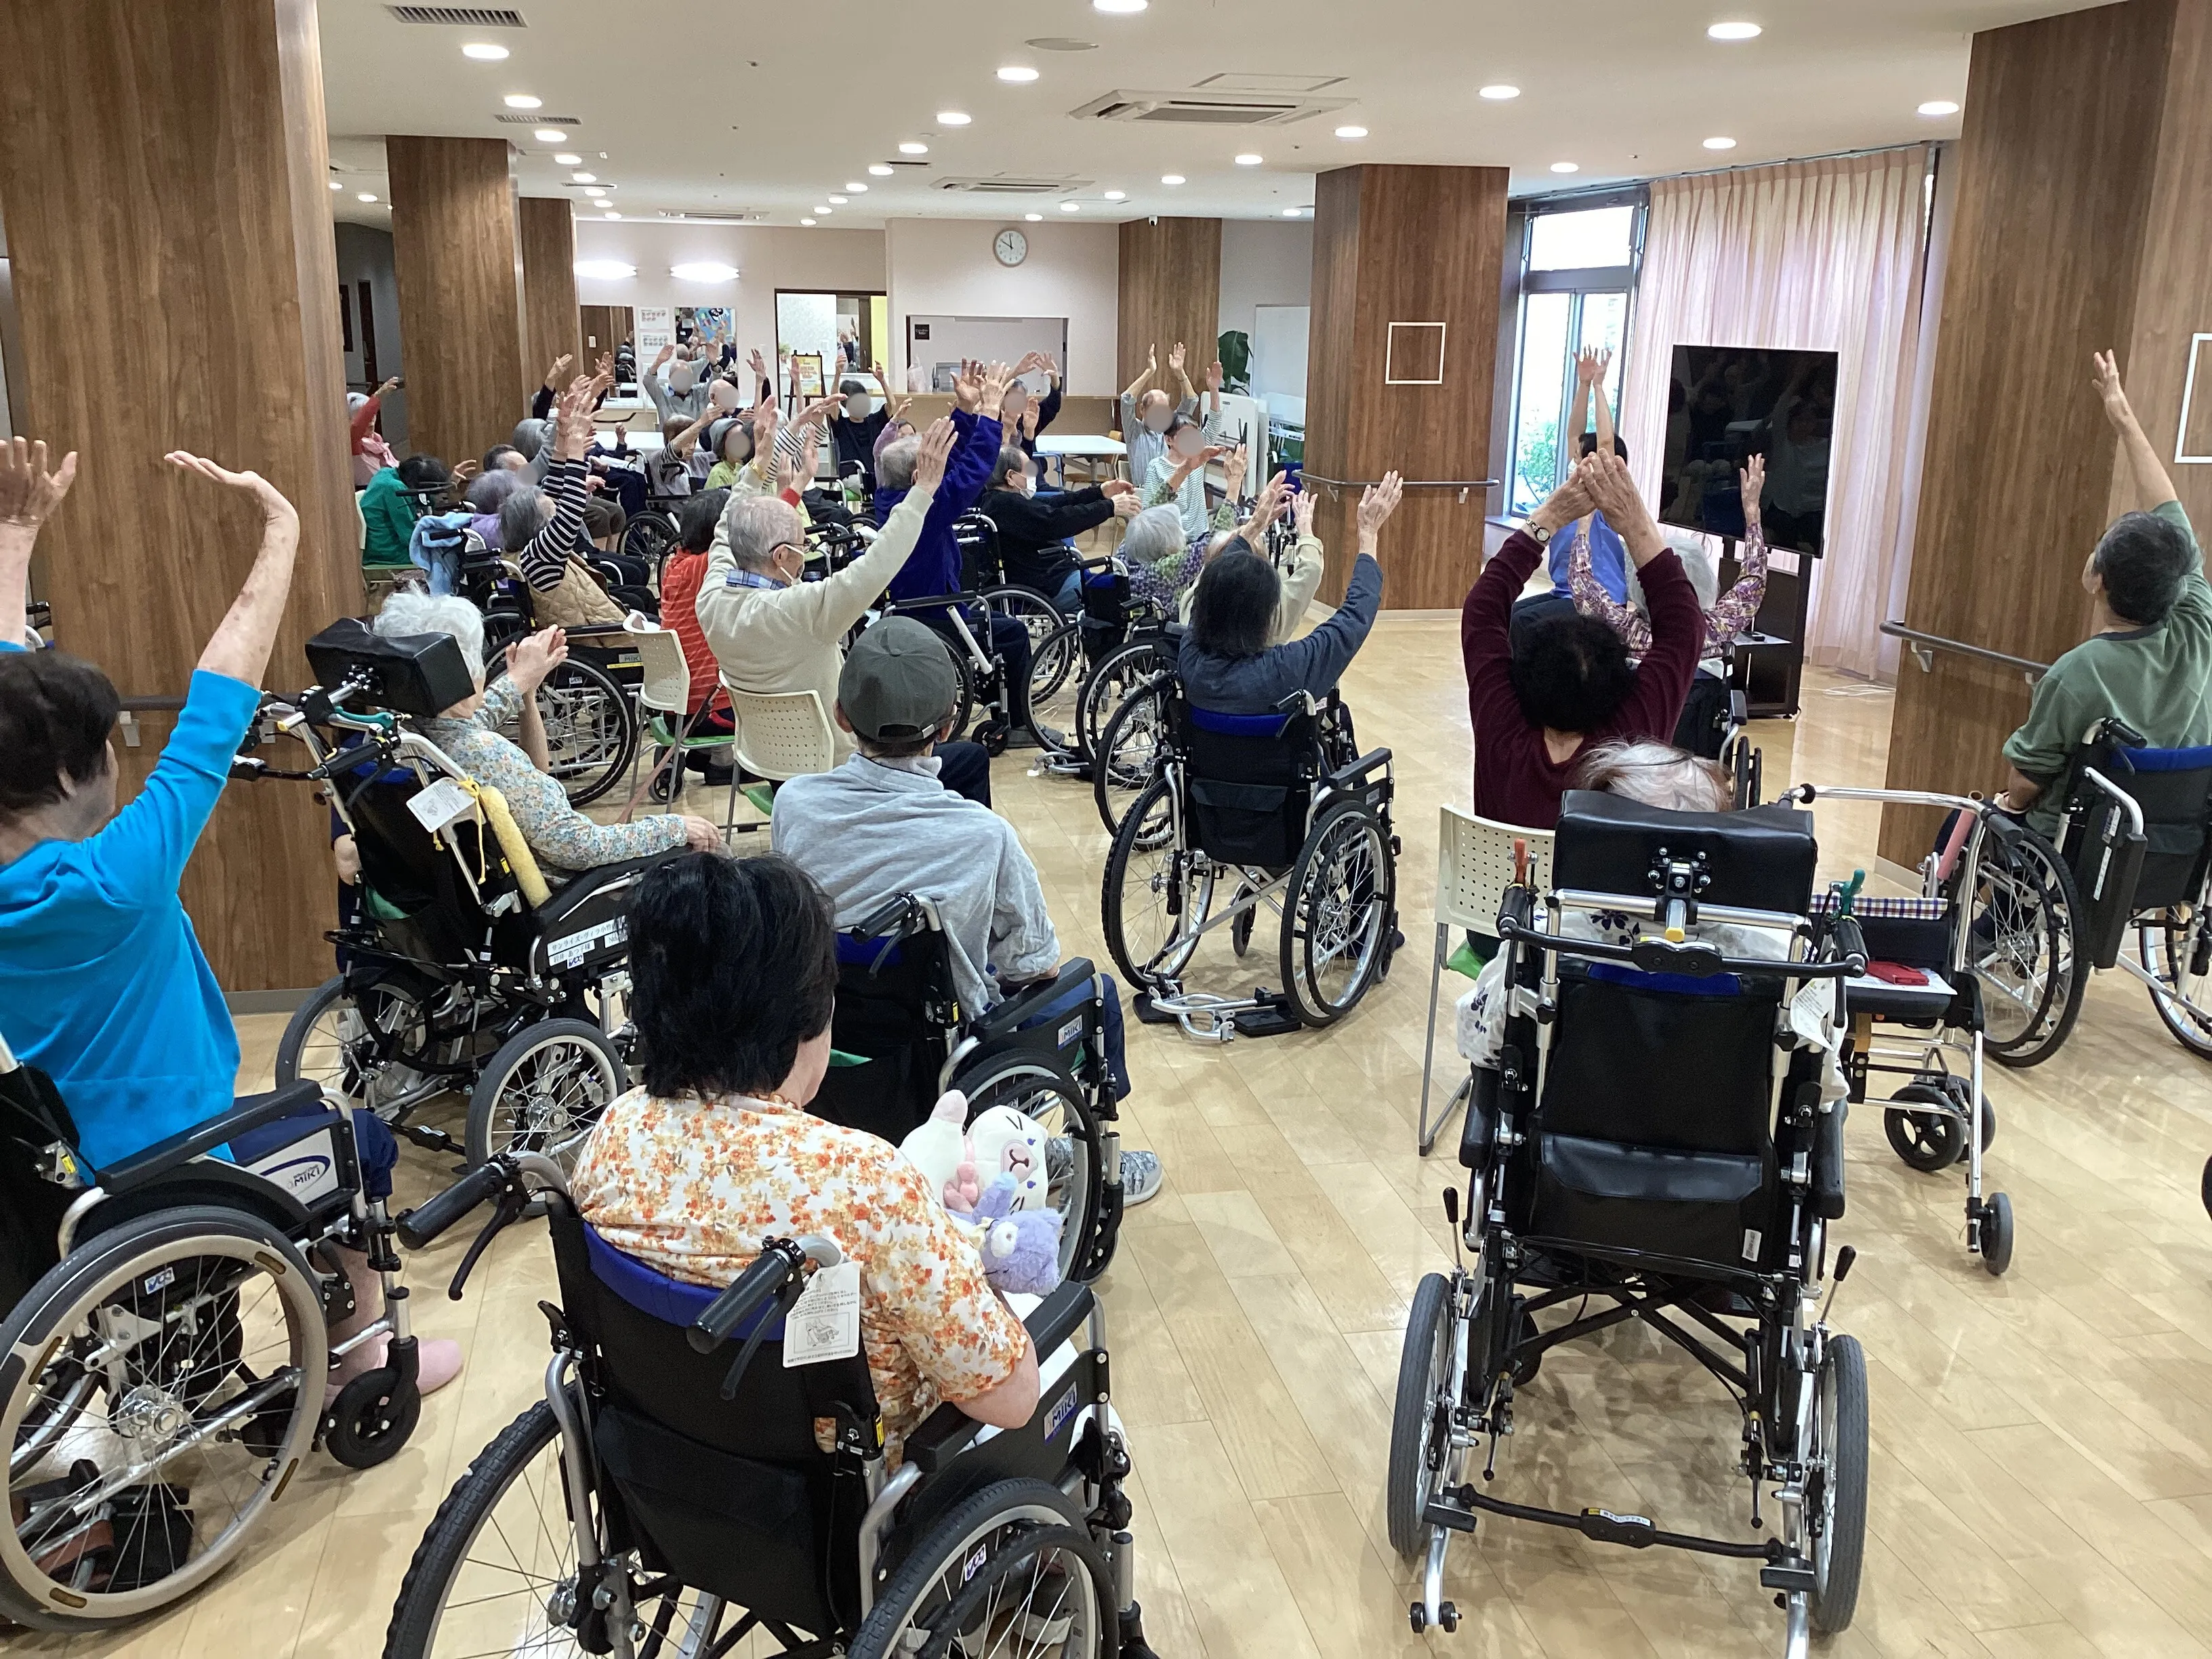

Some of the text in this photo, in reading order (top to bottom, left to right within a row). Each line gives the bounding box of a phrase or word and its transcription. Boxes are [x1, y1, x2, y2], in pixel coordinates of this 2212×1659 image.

[1064, 1021, 1082, 1040] MIKI
[294, 1167, 321, 1187] MIKI
[1052, 1391, 1076, 1428] MIKI
